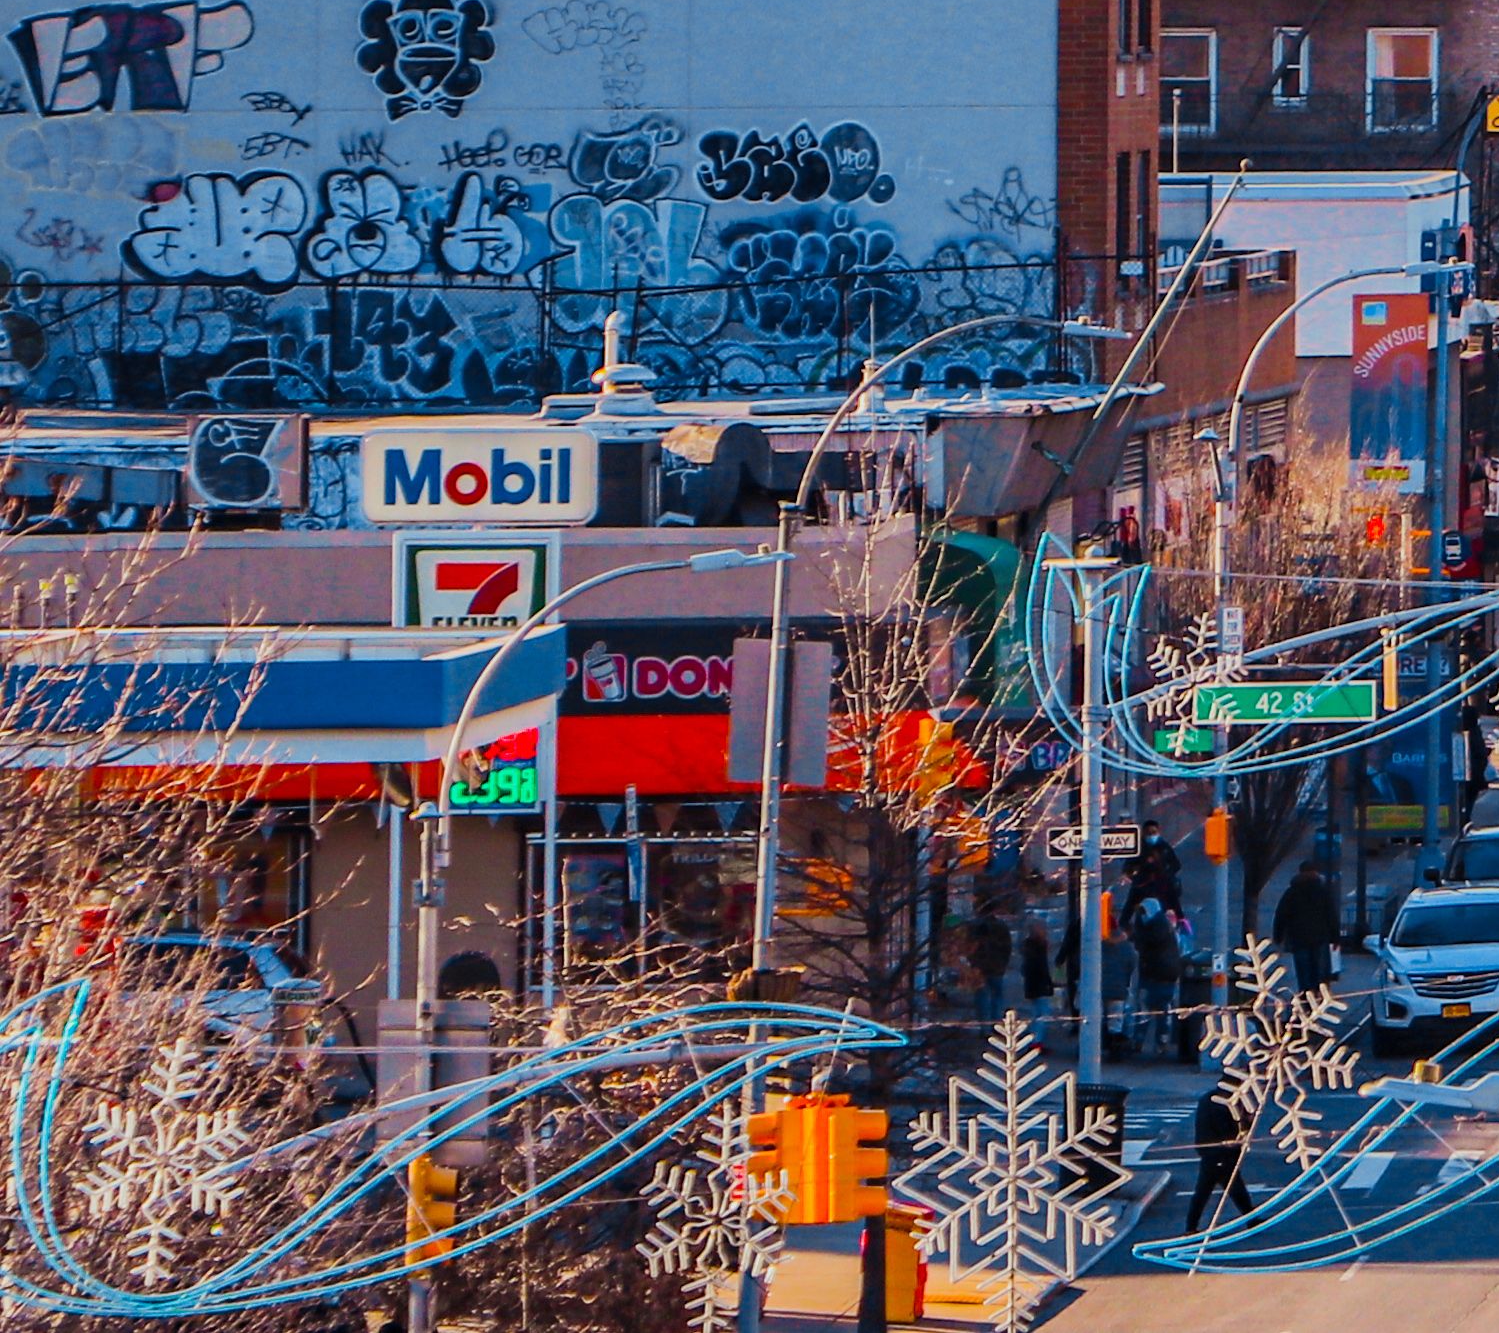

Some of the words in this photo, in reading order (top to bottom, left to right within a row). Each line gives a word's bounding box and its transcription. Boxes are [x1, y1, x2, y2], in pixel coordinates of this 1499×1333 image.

[1353, 323, 1427, 379] SUNNYSIDE
[383, 447, 571, 506] Mobil
[435, 558, 520, 616] 7
[1254, 691, 1284, 715] 42
[1291, 691, 1316, 714] St
[1102, 835, 1131, 847] WAY
